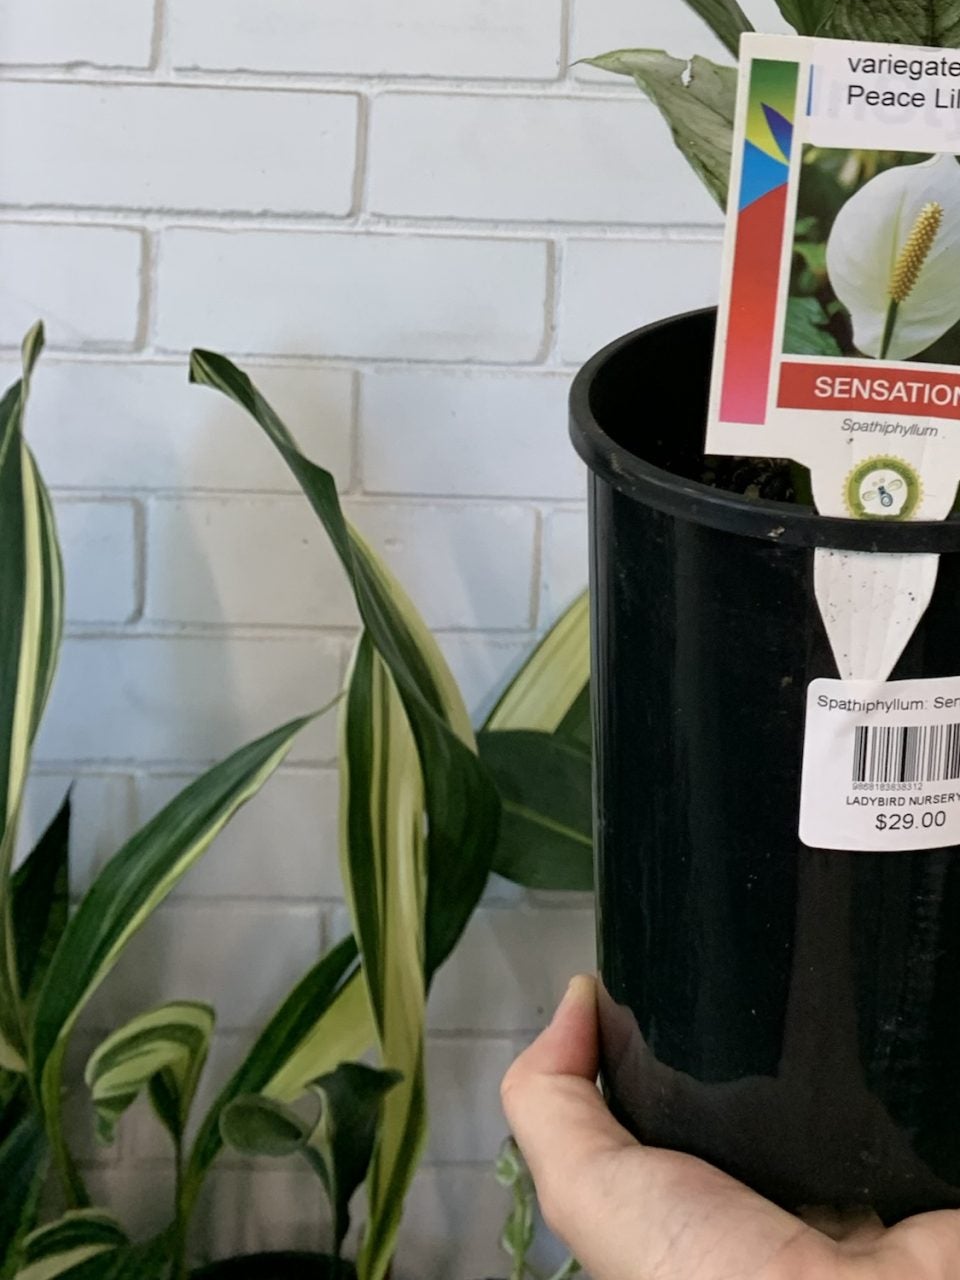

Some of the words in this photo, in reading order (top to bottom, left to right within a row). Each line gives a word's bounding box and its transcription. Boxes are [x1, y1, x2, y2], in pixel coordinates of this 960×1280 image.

[847, 84, 926, 108] Peace
[841, 418, 939, 438] Spathiphyllum
[817, 694, 928, 714] Spathiphyllum:
[846, 795, 906, 807] LADYBIRD
[875, 810, 947, 831] $29.00
